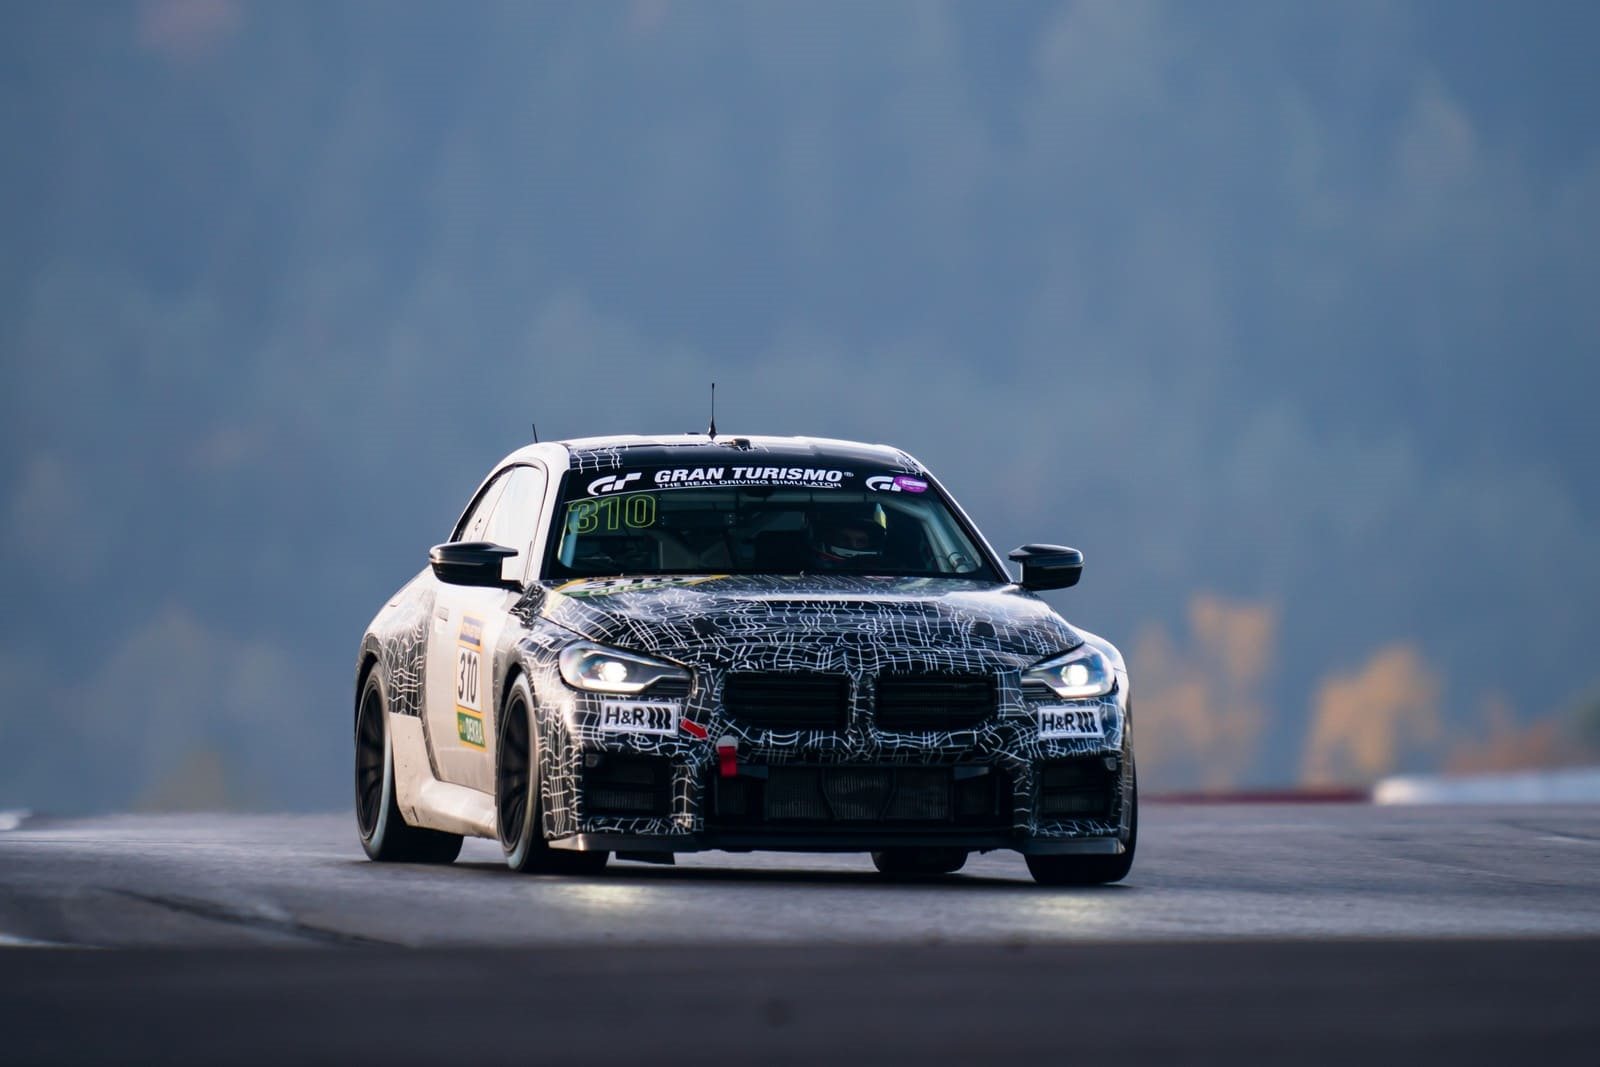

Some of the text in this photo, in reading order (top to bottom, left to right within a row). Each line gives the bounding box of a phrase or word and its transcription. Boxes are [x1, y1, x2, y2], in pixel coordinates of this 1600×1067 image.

[654, 467, 725, 483] GRAN
[771, 479, 843, 488] SIMULATOR
[568, 494, 656, 534] 310
[458, 651, 478, 704] 310
